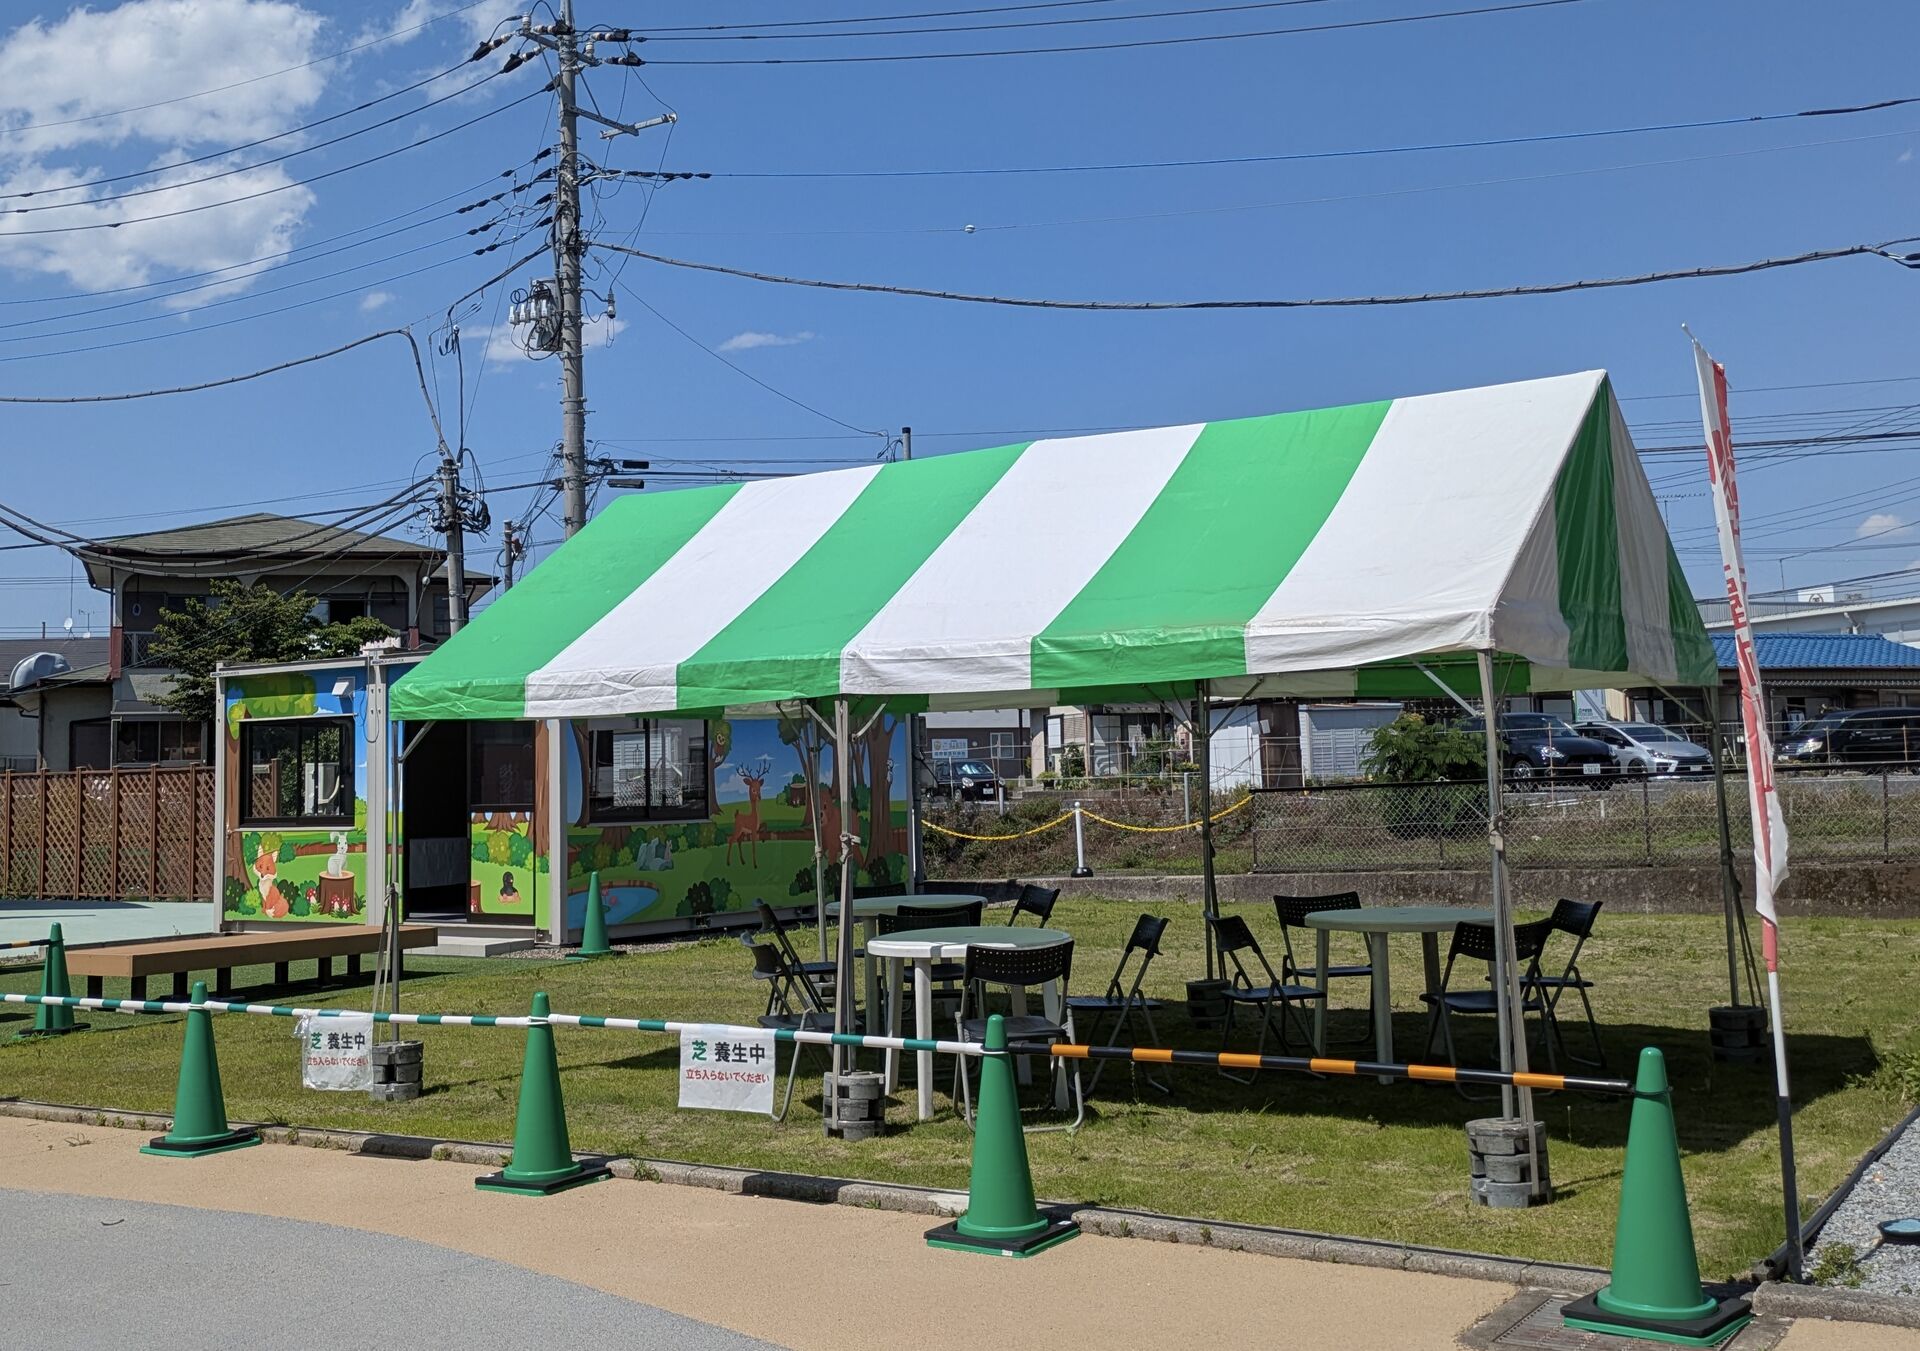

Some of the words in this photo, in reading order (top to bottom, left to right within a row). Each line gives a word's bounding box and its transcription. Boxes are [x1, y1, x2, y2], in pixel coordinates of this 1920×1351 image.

[311, 1032, 322, 1049] 芝
[327, 1032, 366, 1050] 養生中
[692, 1040, 707, 1061] 芝
[714, 1042, 765, 1065] 養生中
[686, 1068, 770, 1084] 立ち入らないでください
